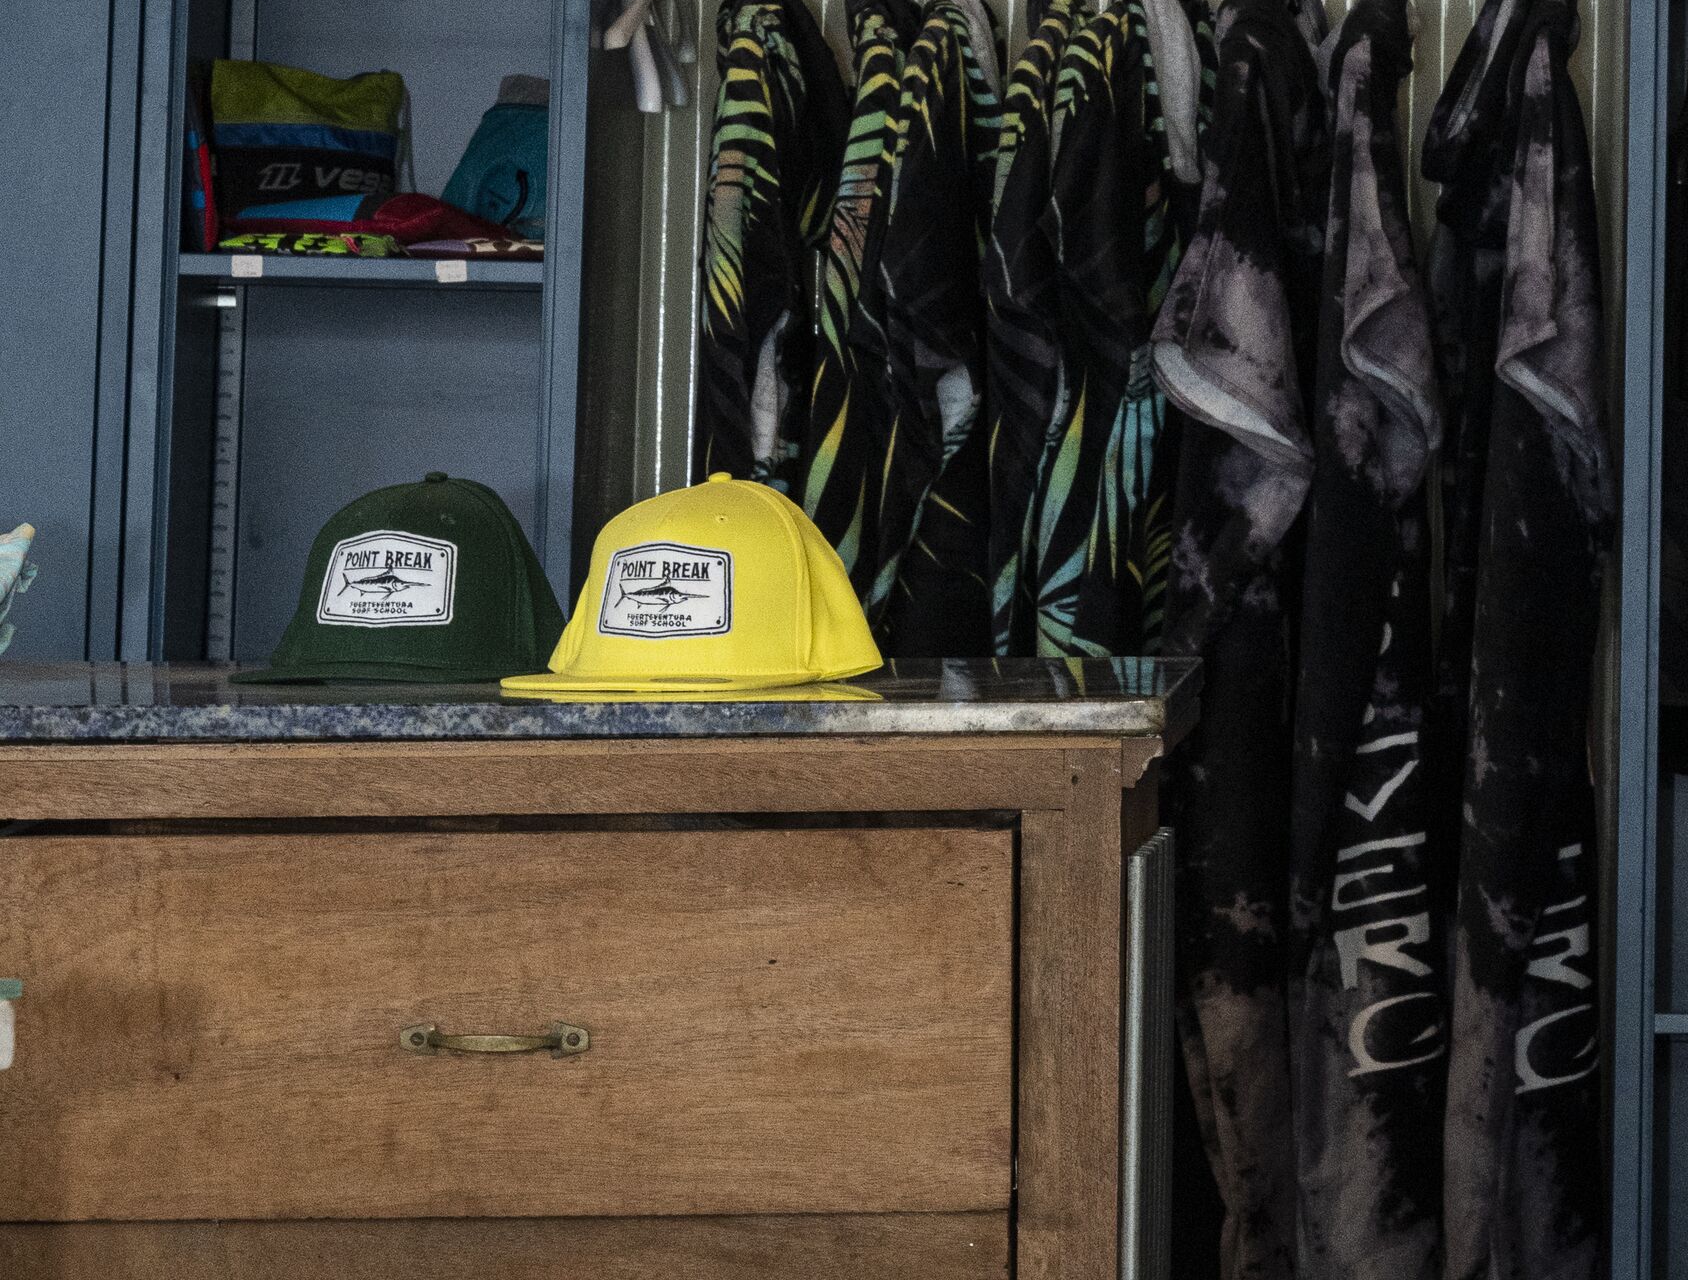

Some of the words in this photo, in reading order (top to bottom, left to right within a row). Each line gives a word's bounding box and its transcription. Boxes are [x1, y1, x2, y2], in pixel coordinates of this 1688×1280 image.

[345, 550, 380, 567] POINT
[385, 550, 432, 569] BREAK
[620, 561, 656, 578] POINT
[662, 561, 710, 579] BREAK
[349, 601, 413, 609] FUERTEVENTURA
[627, 613, 692, 621] FUERTEVENTURA
